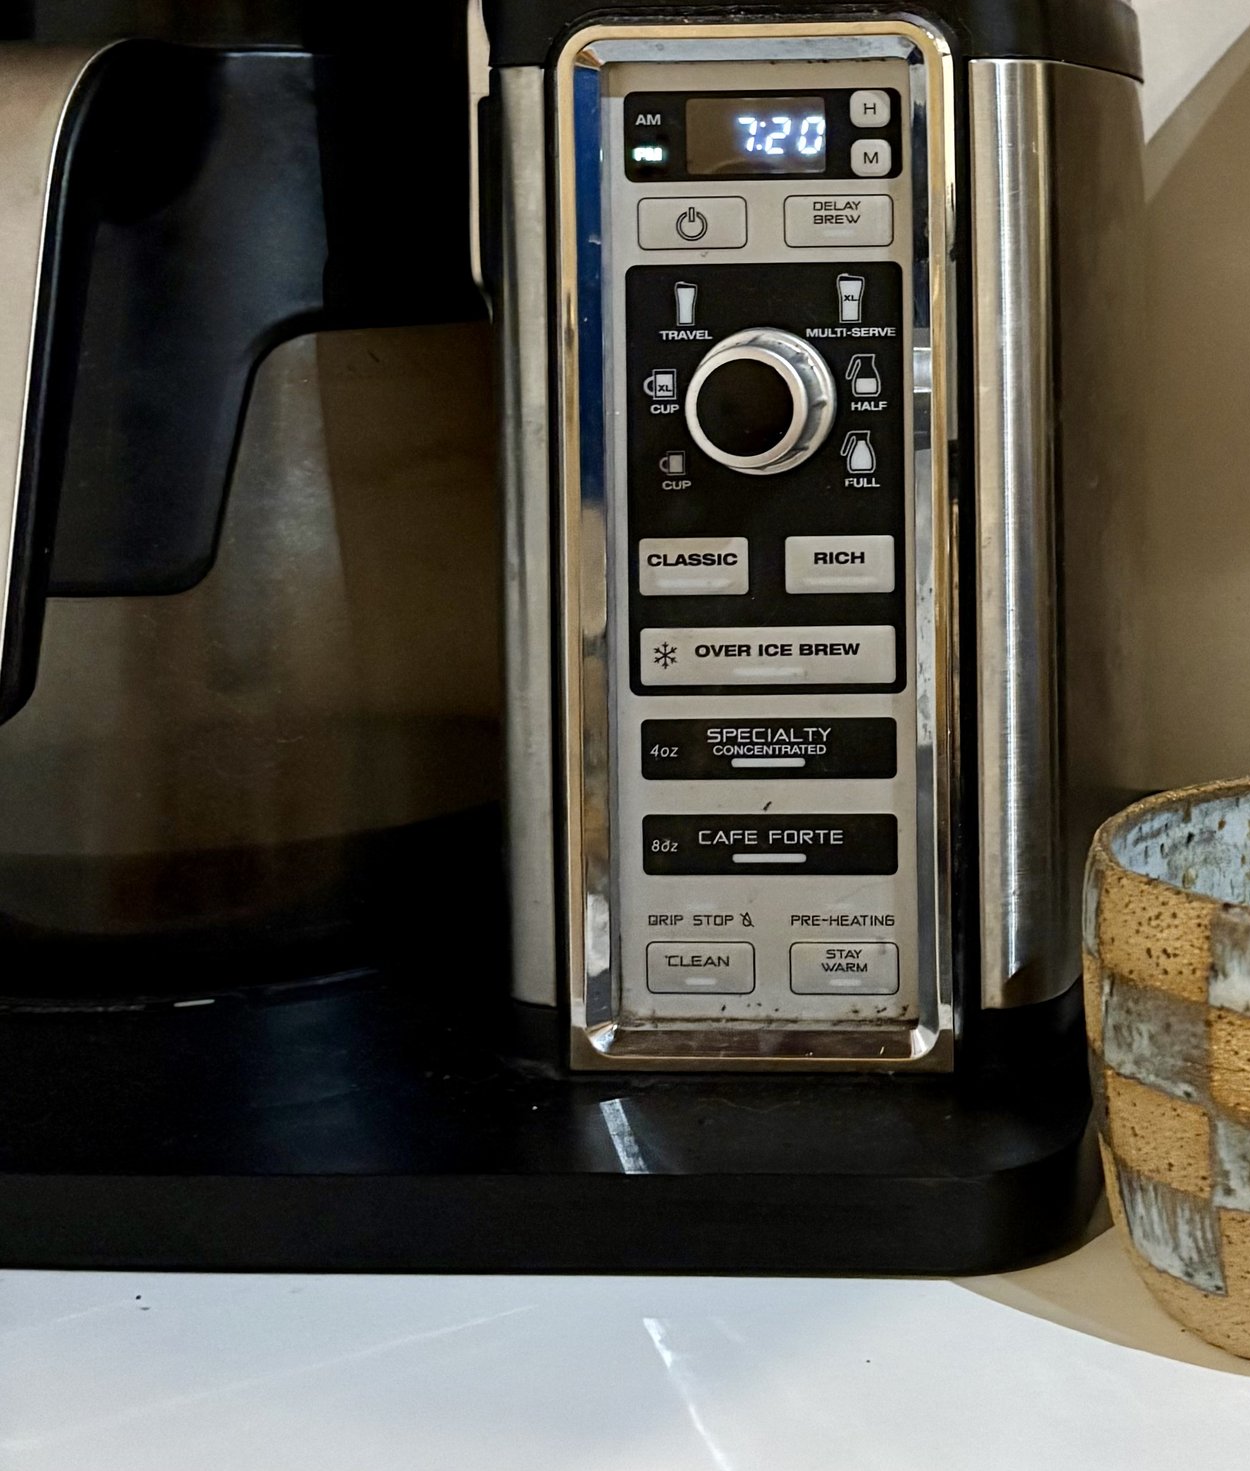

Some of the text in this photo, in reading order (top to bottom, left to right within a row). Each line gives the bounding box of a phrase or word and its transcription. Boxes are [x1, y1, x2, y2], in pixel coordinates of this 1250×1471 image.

[863, 102, 877, 115] H
[635, 113, 662, 126] AM
[737, 115, 826, 155] 7:20
[863, 152, 879, 164] M
[812, 201, 861, 212] DELAY
[813, 214, 861, 225] BREW
[843, 294, 858, 302] XL
[659, 330, 713, 341] TRAVEL
[806, 328, 897, 338] MULTI-SERVE
[657, 384, 674, 393] XL
[650, 404, 680, 415] CUP
[851, 401, 888, 412] HALF
[662, 480, 692, 491] CUP
[845, 478, 881, 488] FULL
[647, 553, 738, 567] CLASSIC
[813, 551, 866, 565] RICH
[694, 643, 861, 659] OVER ICE BREW
[706, 728, 832, 744] SPECIALTY
[712, 744, 827, 756] CONCENTRATED
[698, 830, 844, 846] CAFE FORTE
[693, 914, 734, 926] STOP
[790, 914, 896, 927] PRE-HEATING
[826, 949, 863, 960] STAY
[667, 955, 730, 968] CLEAN
[821, 962, 869, 973] WARM
